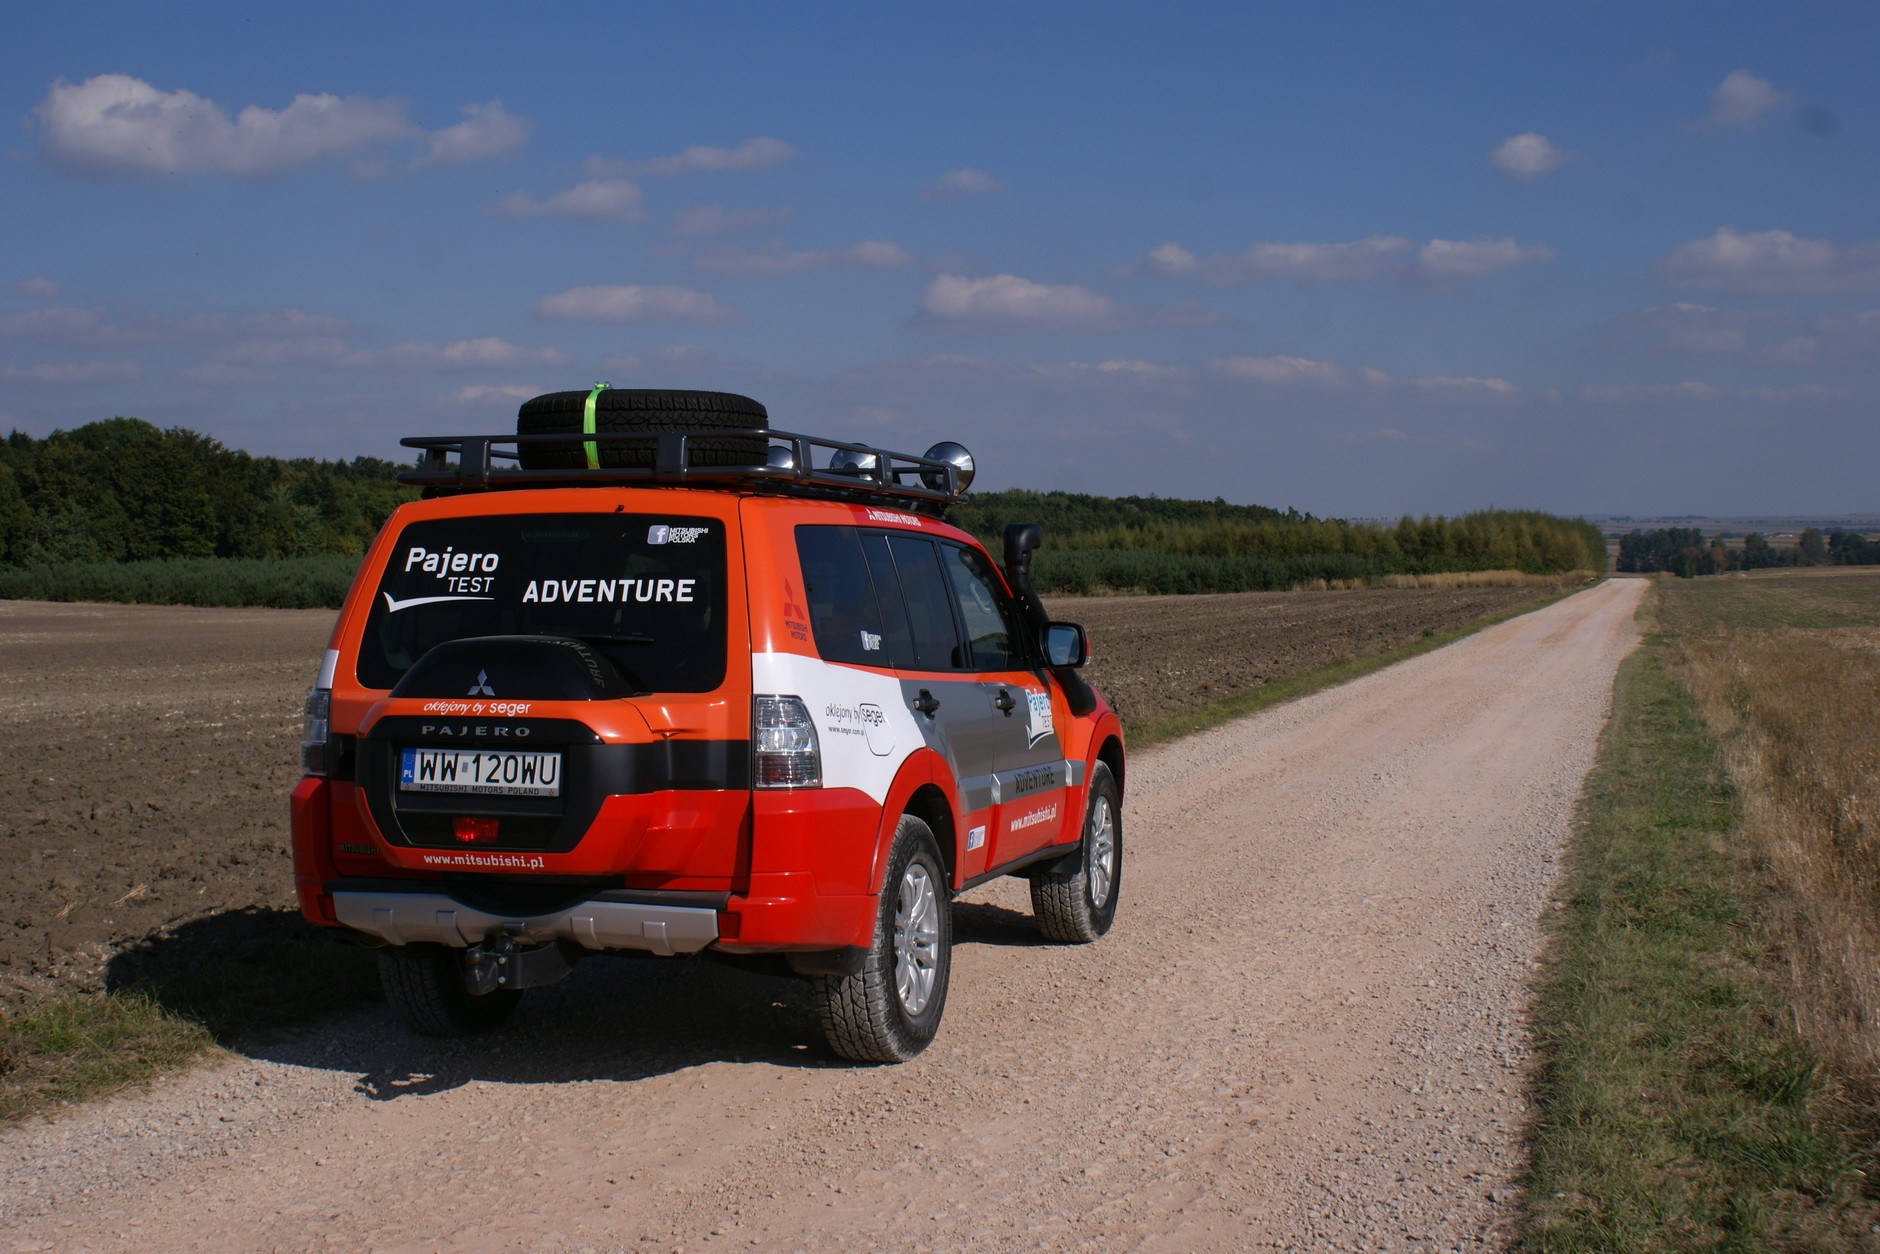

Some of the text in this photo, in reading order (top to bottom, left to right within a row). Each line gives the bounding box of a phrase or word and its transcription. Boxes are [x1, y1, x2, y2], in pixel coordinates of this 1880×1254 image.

[405, 546, 499, 579] Pajero
[448, 576, 495, 593] TEST
[522, 579, 696, 603] ADVENTURE
[423, 701, 531, 717] oklejony by seger
[825, 703, 886, 728] oklejony by seger
[421, 725, 531, 737] PAJERO
[403, 769, 413, 779] PL
[420, 751, 557, 785] WW 120WU
[419, 783, 540, 796] MITSUBISHI MOTORS POLAND
[1014, 766, 1056, 794] ADVENTURE
[1010, 803, 1057, 833] www.mitsubishi.pl
[423, 854, 545, 870] www.mitsubishi.pl
